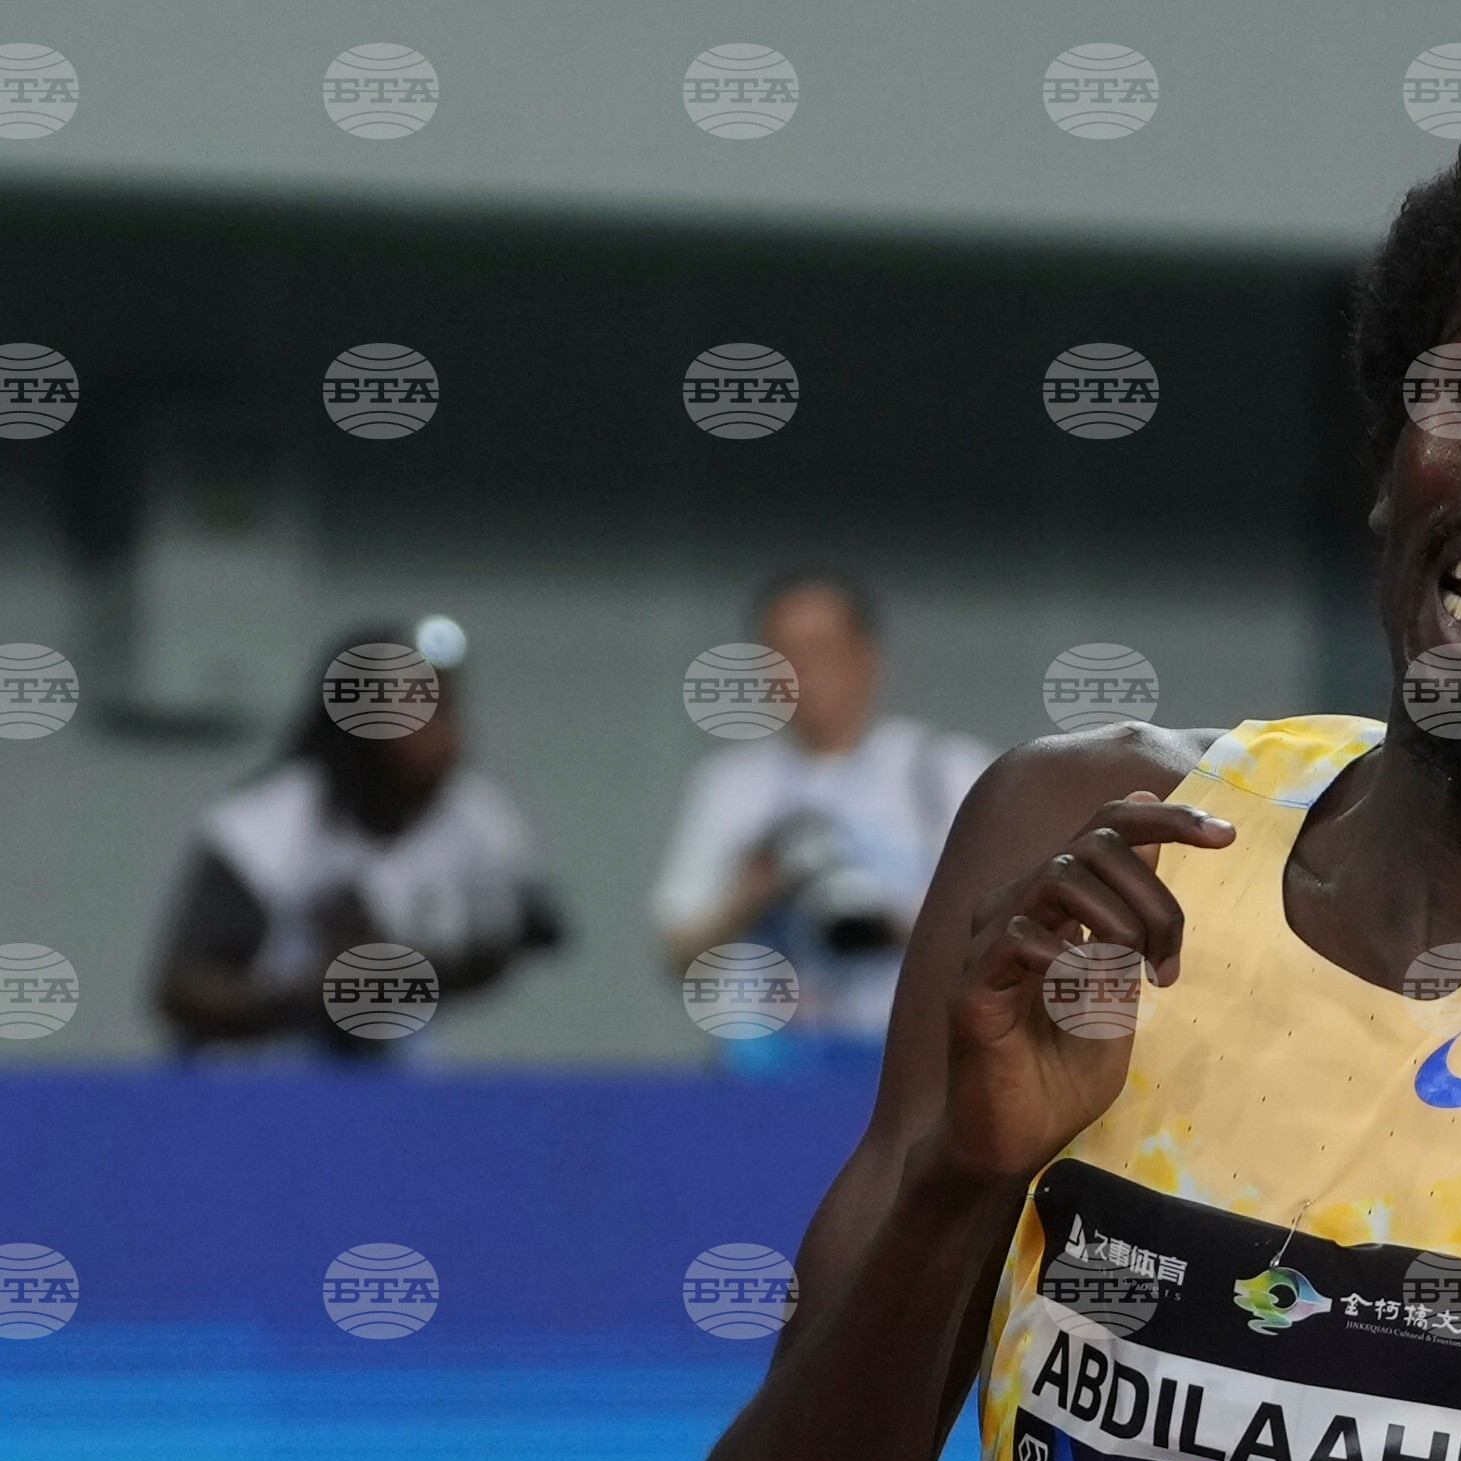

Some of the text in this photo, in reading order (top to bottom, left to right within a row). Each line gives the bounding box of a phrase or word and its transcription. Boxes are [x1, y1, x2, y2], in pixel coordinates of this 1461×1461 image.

[1094, 1229, 1188, 1286] 久事体育
[1345, 1320, 1393, 1335] JINKEQIAO
